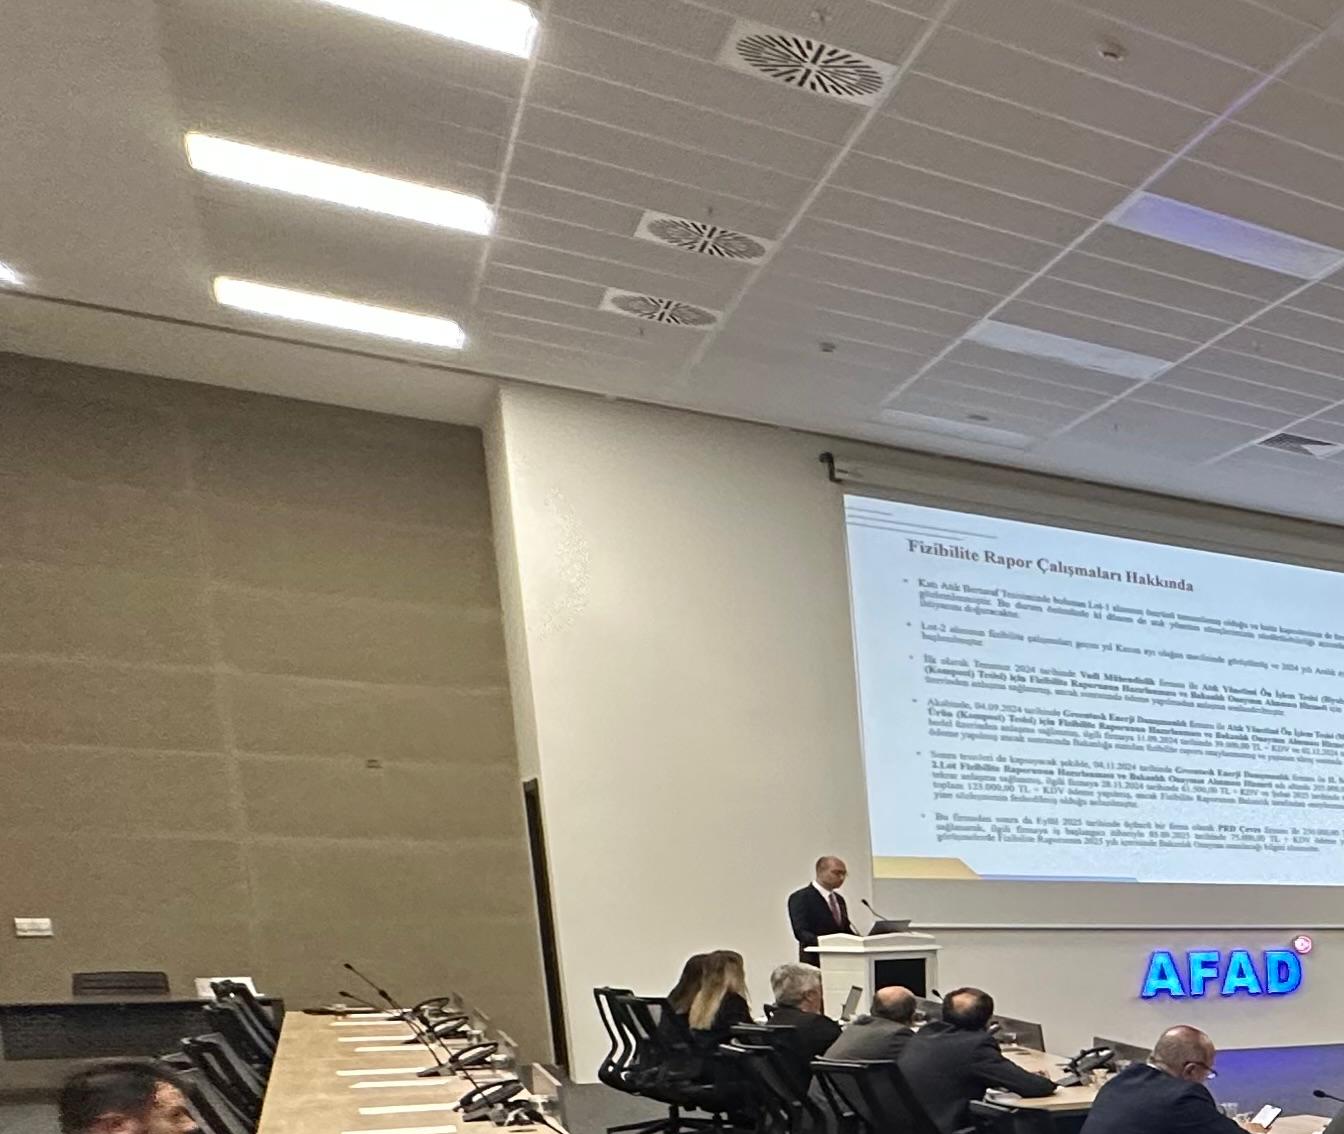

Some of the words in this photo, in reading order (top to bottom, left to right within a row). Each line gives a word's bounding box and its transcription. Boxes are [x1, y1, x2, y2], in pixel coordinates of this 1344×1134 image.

[908, 540, 979, 562] Fizibilite
[984, 550, 1033, 570] Rapor
[1037, 558, 1122, 583] Çalışmaları
[1126, 570, 1194, 592] Hakkında
[1141, 950, 1302, 998] AFAD
